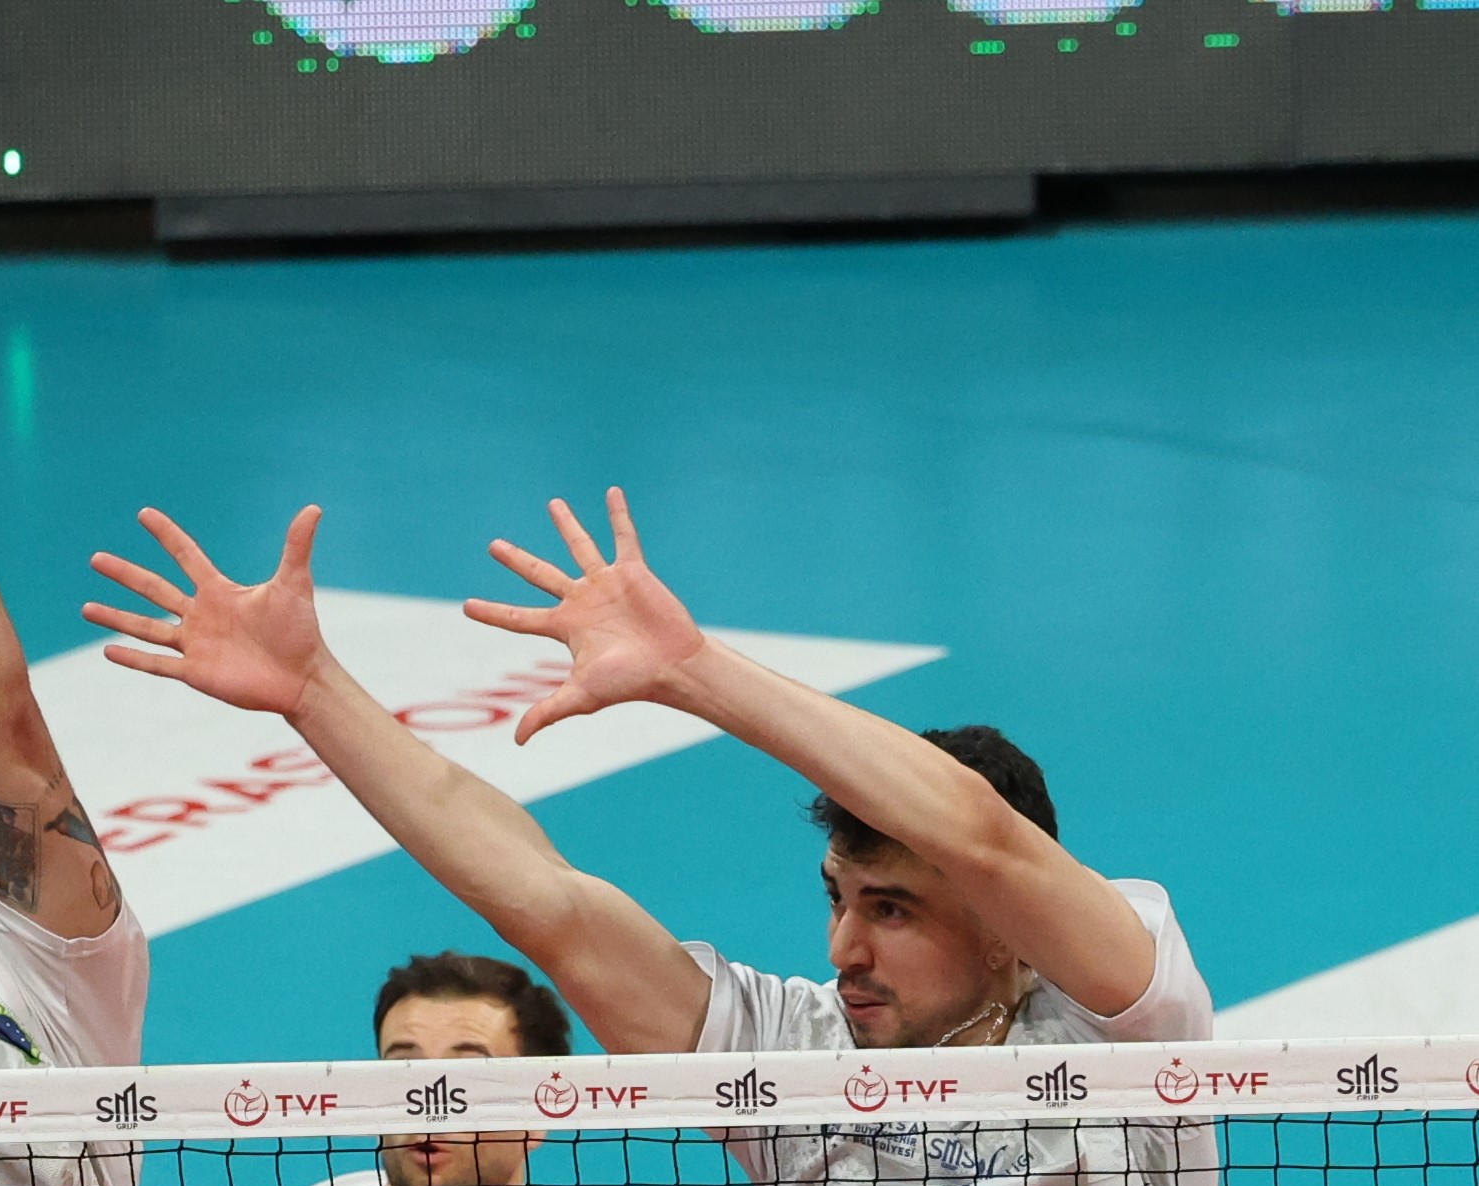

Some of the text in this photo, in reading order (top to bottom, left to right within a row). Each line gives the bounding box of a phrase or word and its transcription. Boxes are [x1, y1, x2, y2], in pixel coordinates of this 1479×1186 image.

[1026, 1061, 1088, 1103] SMS
[1206, 1072, 1269, 1096] TVF
[1337, 1053, 1399, 1095] SMS
[406, 1075, 468, 1117] SMS
[585, 1086, 648, 1110] TVF
[716, 1068, 778, 1110] SMS
[895, 1079, 958, 1104] TVF
[96, 1082, 158, 1124] SMS
[275, 1093, 338, 1117] TVF
[735, 1107, 758, 1116] GRUP
[116, 1122, 139, 1131] GRUP
[426, 1115, 449, 1123] GRUP
